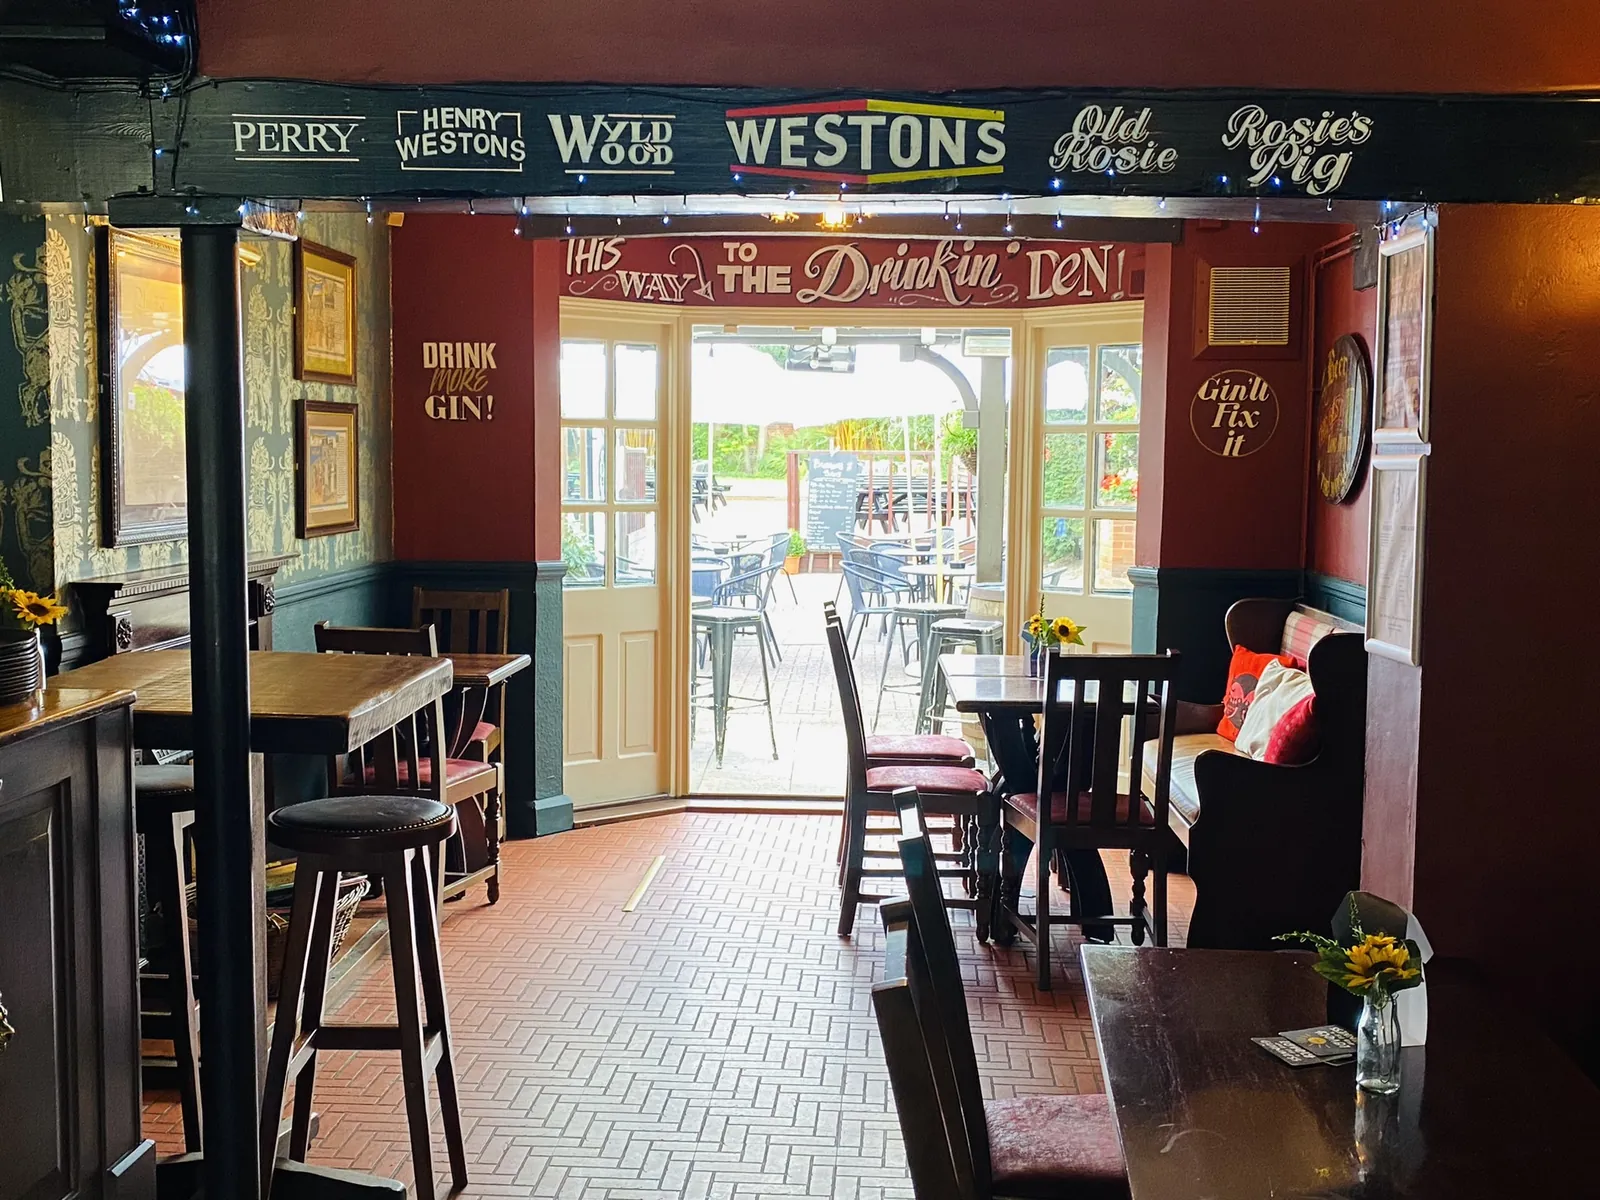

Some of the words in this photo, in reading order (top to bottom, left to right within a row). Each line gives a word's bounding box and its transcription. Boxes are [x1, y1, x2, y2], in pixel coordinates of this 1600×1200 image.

[422, 106, 501, 132] HENRY
[1071, 104, 1152, 144] Old
[1221, 103, 1376, 151] Rosie's
[233, 121, 359, 153] PERRY
[394, 130, 527, 162] WESTONS
[725, 113, 1007, 171] WESTONS
[1048, 131, 1179, 174] Rosie
[1246, 140, 1353, 196] Pig
[722, 241, 758, 263] TO
[615, 269, 697, 303] WAY
[716, 265, 792, 294] THE
[795, 238, 1021, 307] Drinkin'
[422, 341, 497, 369] DRINK
[429, 367, 489, 395] MORE
[1197, 376, 1270, 402] Gin'll
[424, 394, 494, 421] GIN!
[1211, 402, 1261, 429] Fix
[1222, 429, 1247, 457] it
